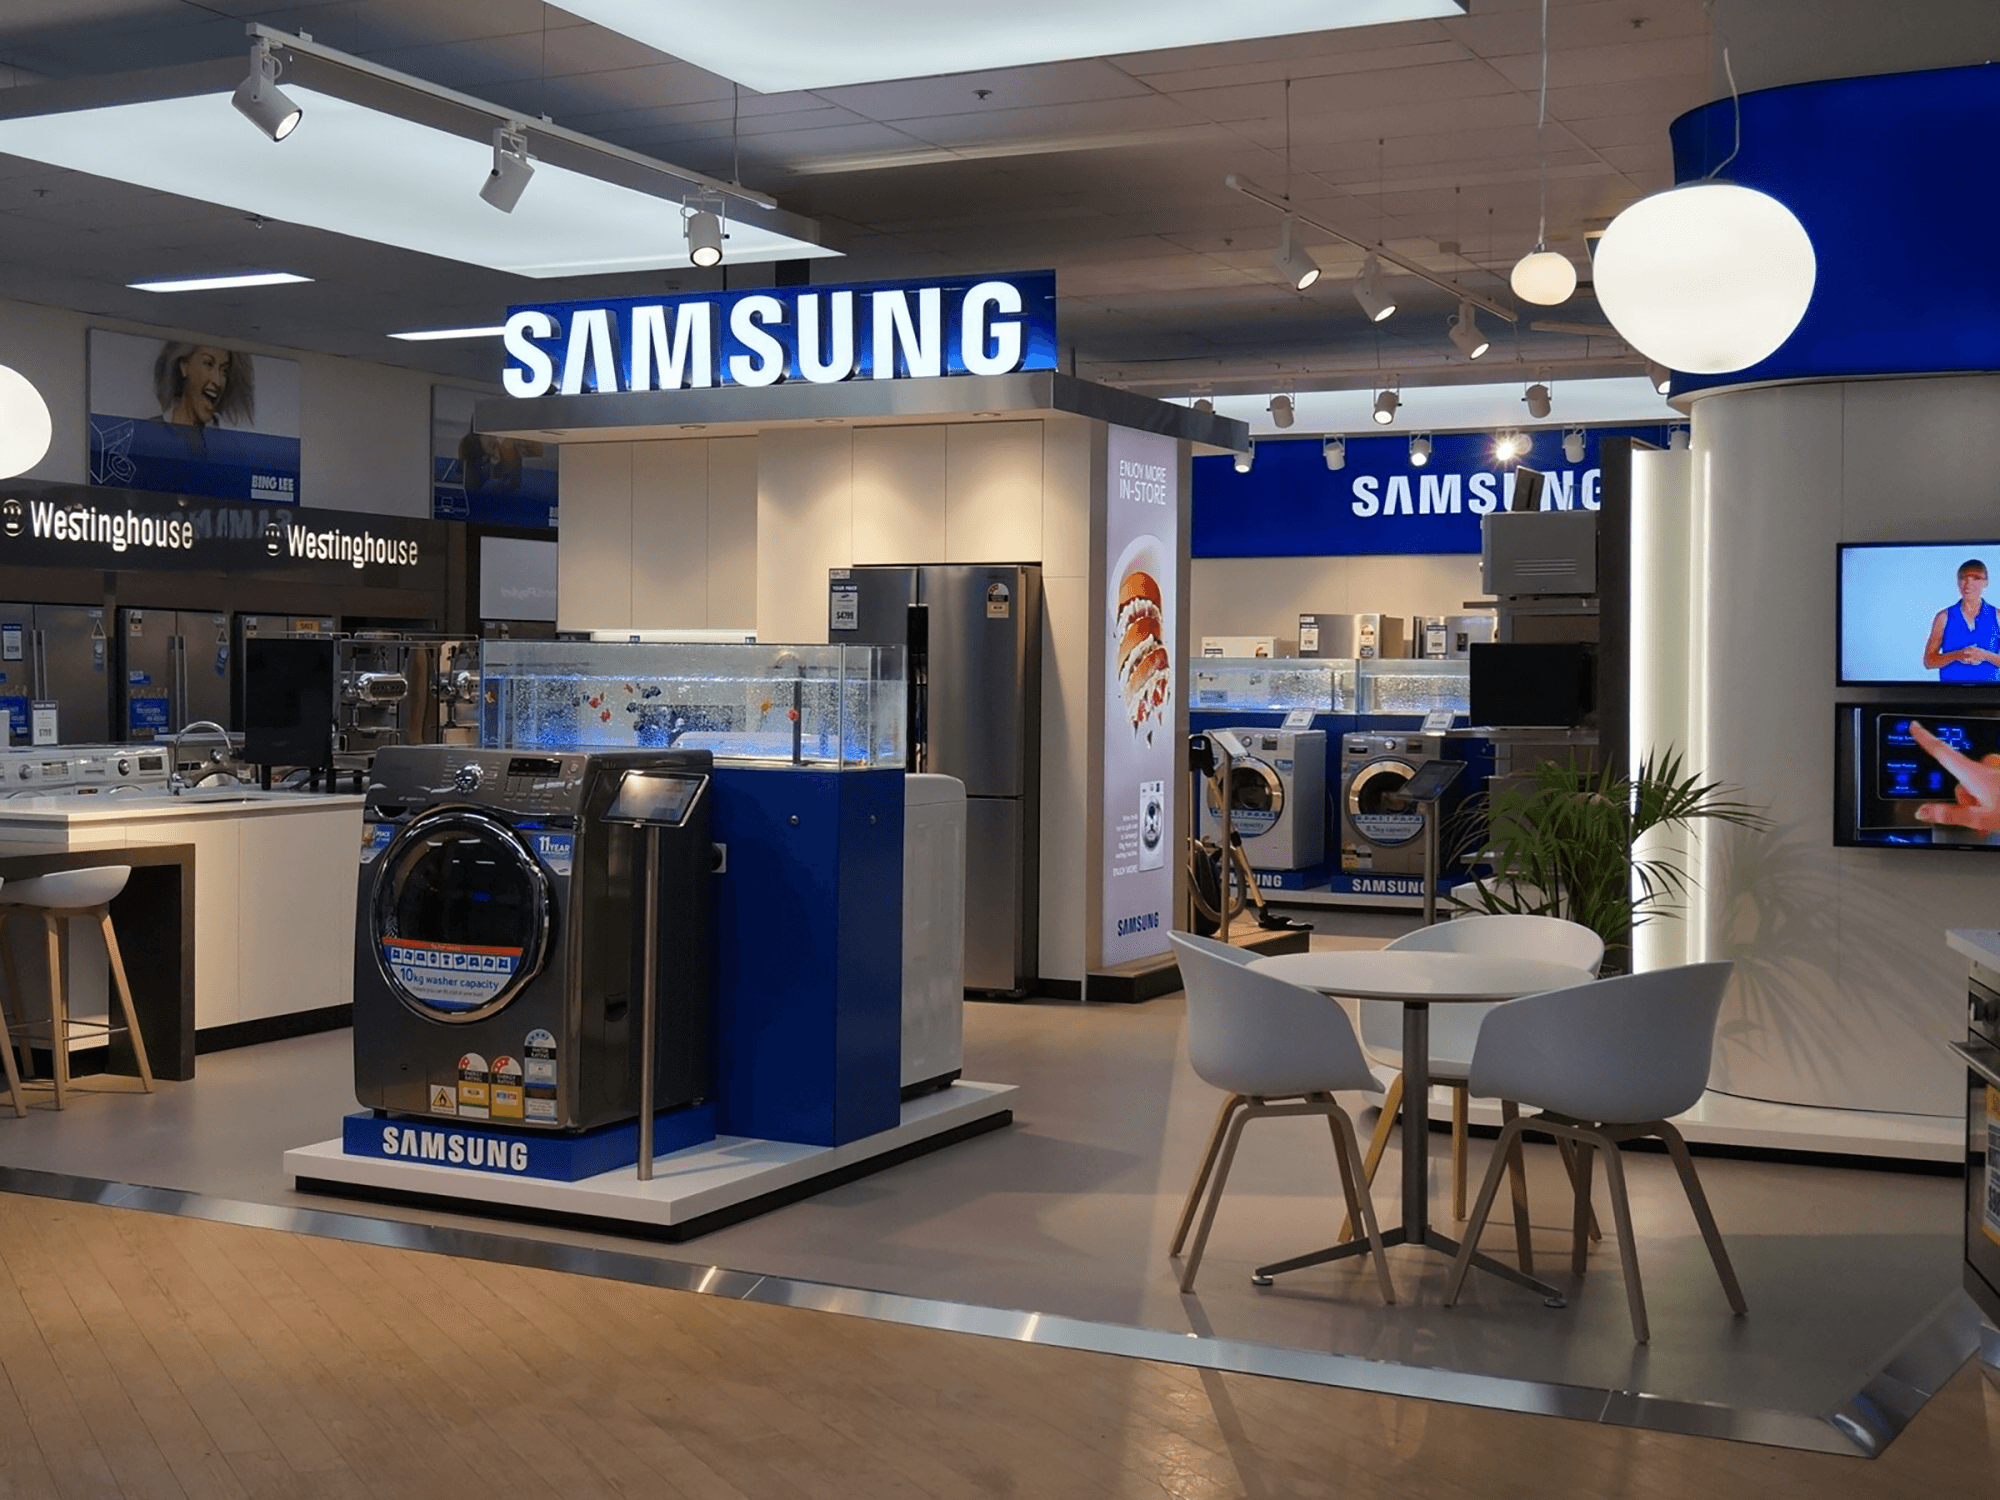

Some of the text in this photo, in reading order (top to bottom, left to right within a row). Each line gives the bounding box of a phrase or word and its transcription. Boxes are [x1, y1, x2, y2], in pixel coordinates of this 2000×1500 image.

[502, 281, 1024, 398] SAMSUNG
[252, 475, 294, 491] BING LEE
[1120, 460, 1166, 483] ENJOY MORE
[1120, 478, 1166, 505] IN-STORE
[31, 500, 195, 552] Westinghouse
[287, 524, 418, 568] Westinghouse
[1117, 911, 1159, 937] SAMSUNG
[400, 967, 499, 991] 10kg washer capacity
[382, 1126, 528, 1171] SAMSUNG
